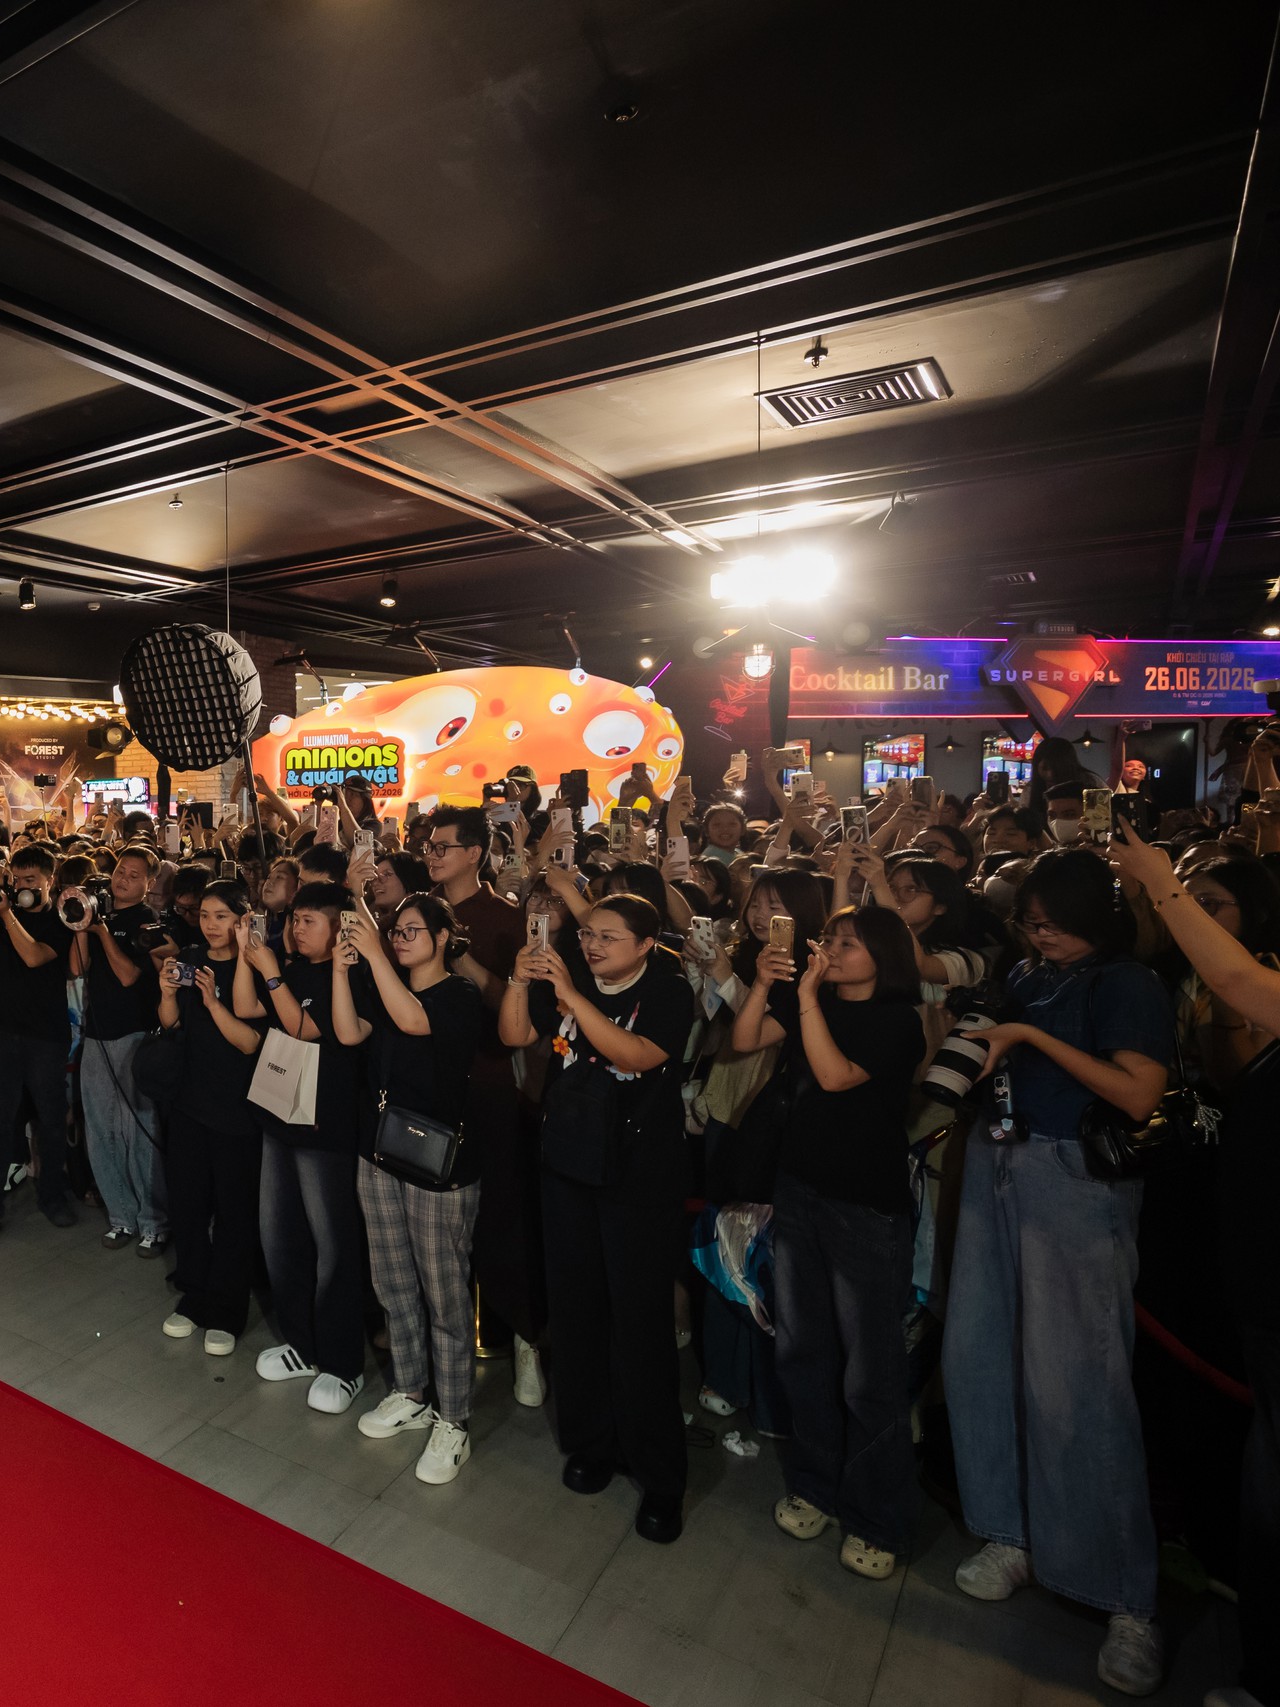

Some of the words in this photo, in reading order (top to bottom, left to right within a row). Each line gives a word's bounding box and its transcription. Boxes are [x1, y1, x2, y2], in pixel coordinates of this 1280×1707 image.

[790, 665, 894, 691] Cocktail
[903, 666, 949, 691] Bar
[990, 669, 1121, 683] SUPERGIRL
[1144, 666, 1255, 691] 26.06.2026
[303, 734, 349, 747] ILLUMINATION
[25, 745, 64, 755] FOREST
[301, 767, 344, 787] quái
[361, 765, 398, 788] vật
